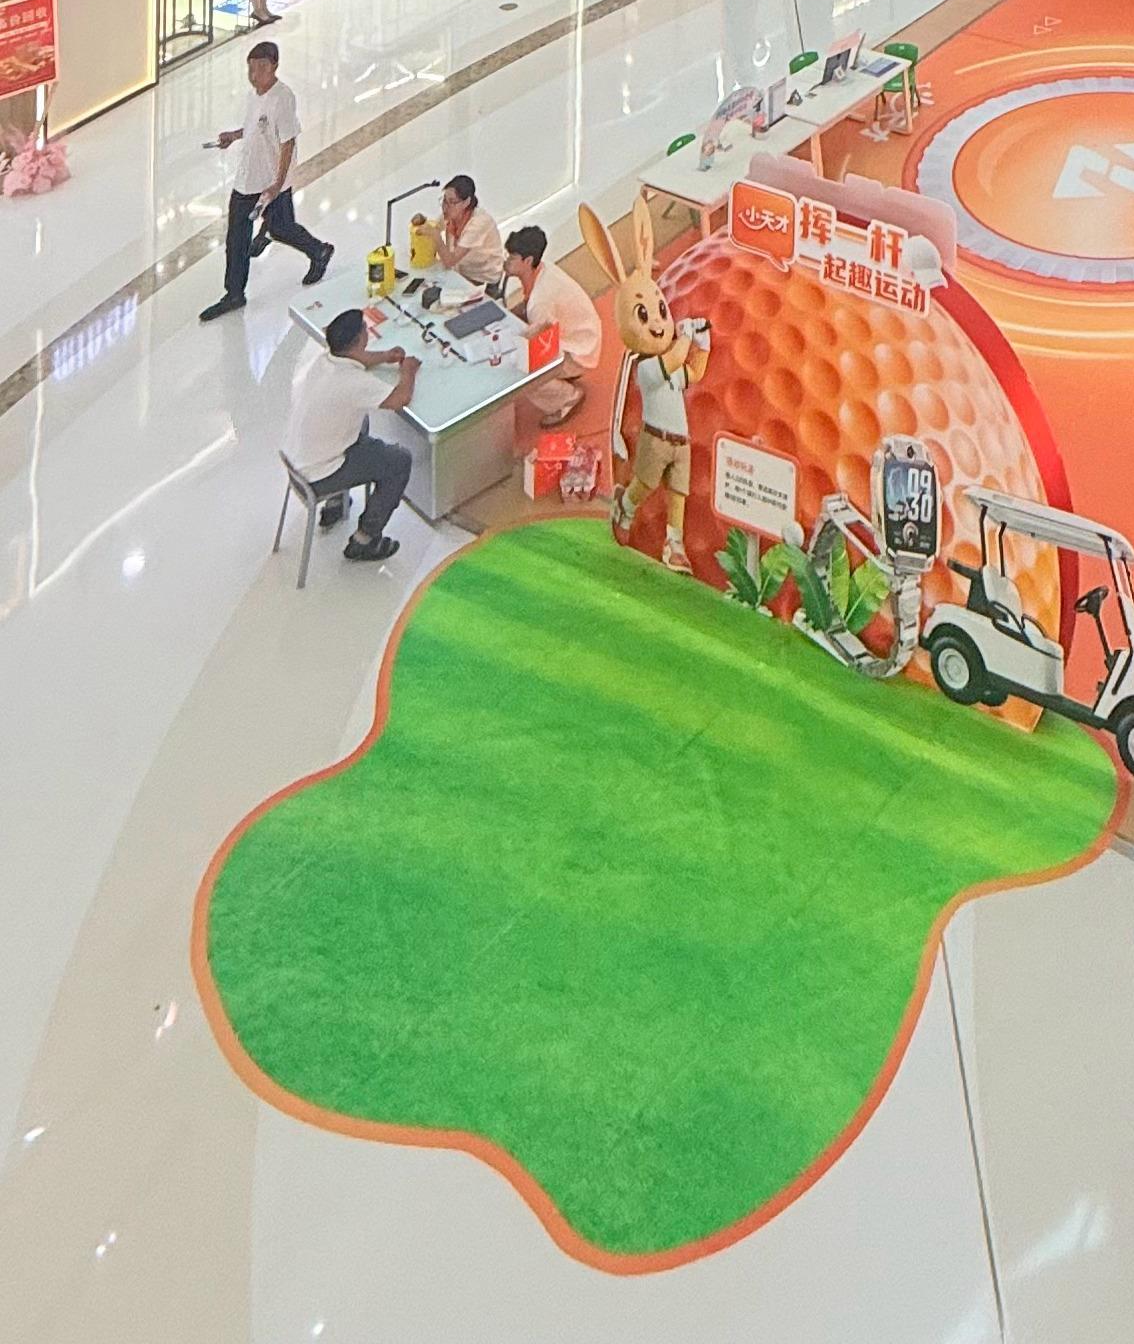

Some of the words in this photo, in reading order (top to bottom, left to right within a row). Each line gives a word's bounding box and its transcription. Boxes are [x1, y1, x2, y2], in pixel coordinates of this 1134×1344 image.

[738, 205, 790, 234] 小天才
[800, 202, 903, 269] 挥一杆
[907, 468, 932, 496] 09
[908, 493, 932, 523] 30
